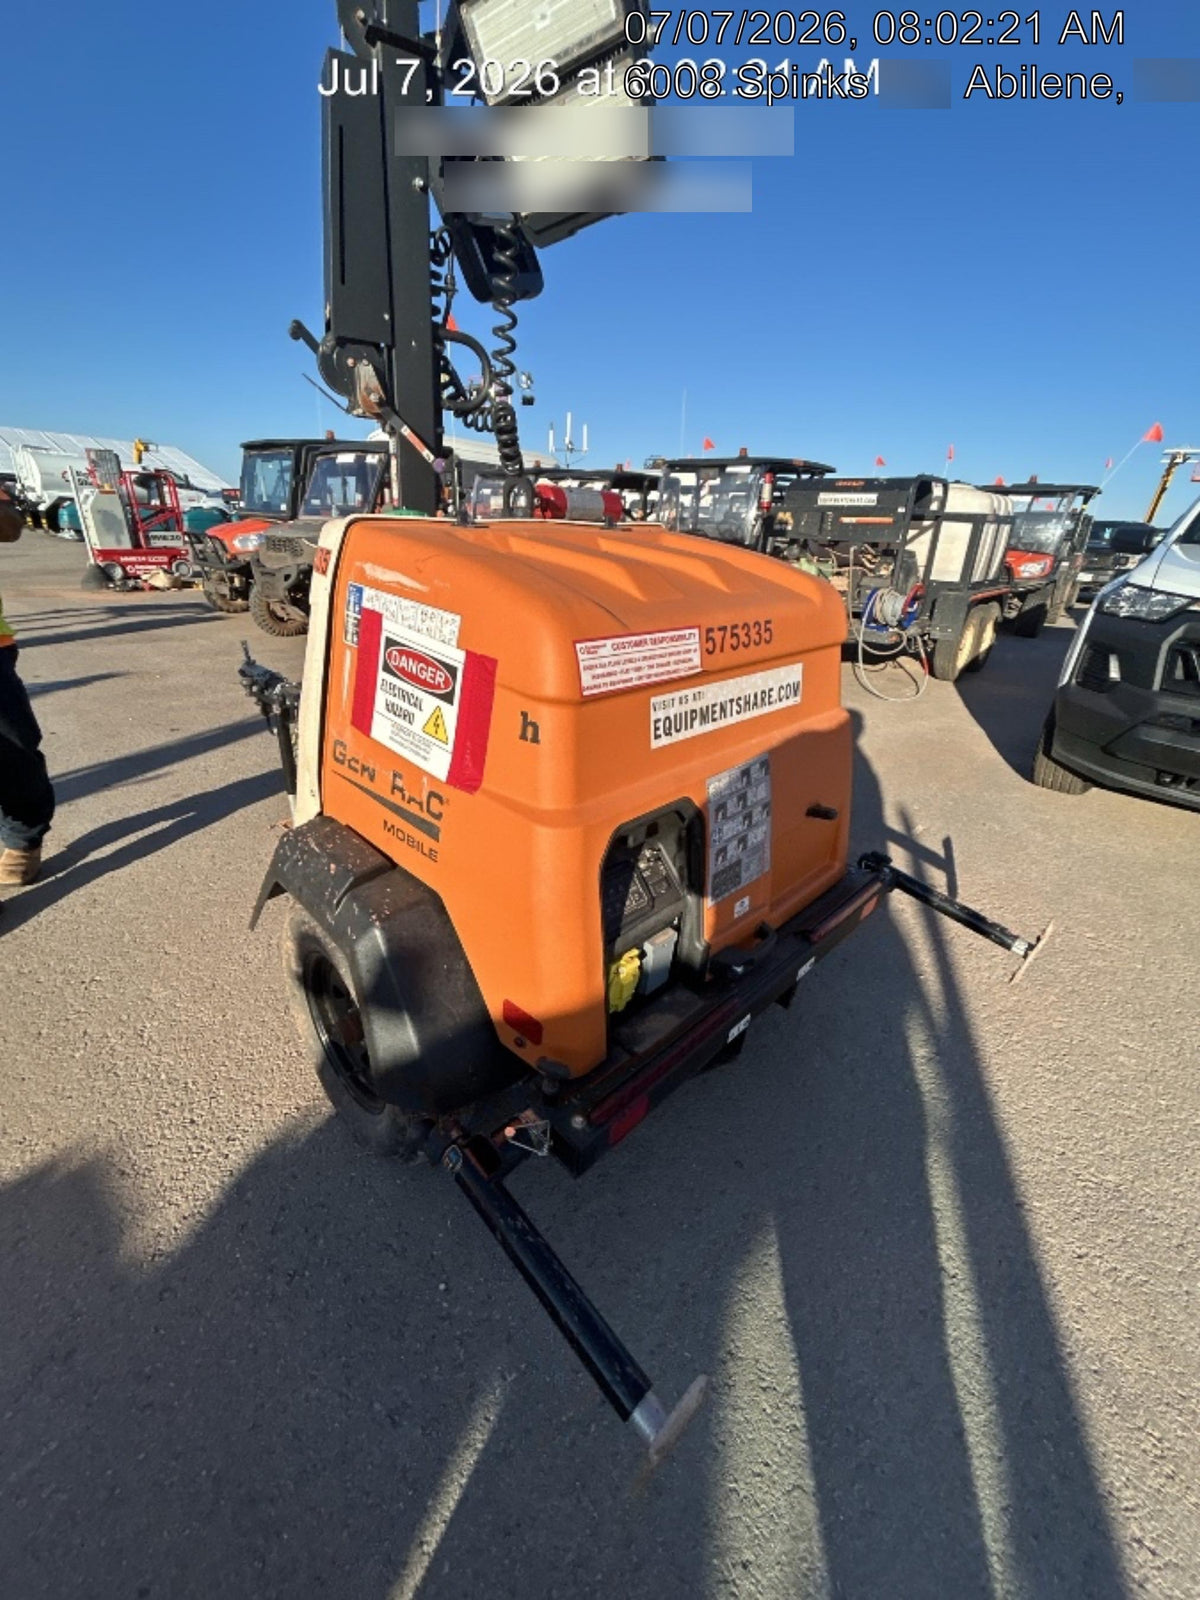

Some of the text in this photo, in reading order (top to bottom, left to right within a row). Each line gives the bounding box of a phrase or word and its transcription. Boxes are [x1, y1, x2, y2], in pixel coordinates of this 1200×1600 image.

[704, 620, 774, 656] 575335
[389, 651, 447, 690] DANGER
[380, 677, 425, 712] ELECTRICAL
[652, 698, 676, 713] VISIT
[678, 694, 690, 706] US
[652, 680, 802, 741] EQUIPMENTSHARE.COM
[518, 710, 541, 745] h
[382, 819, 439, 863] MOBILE
